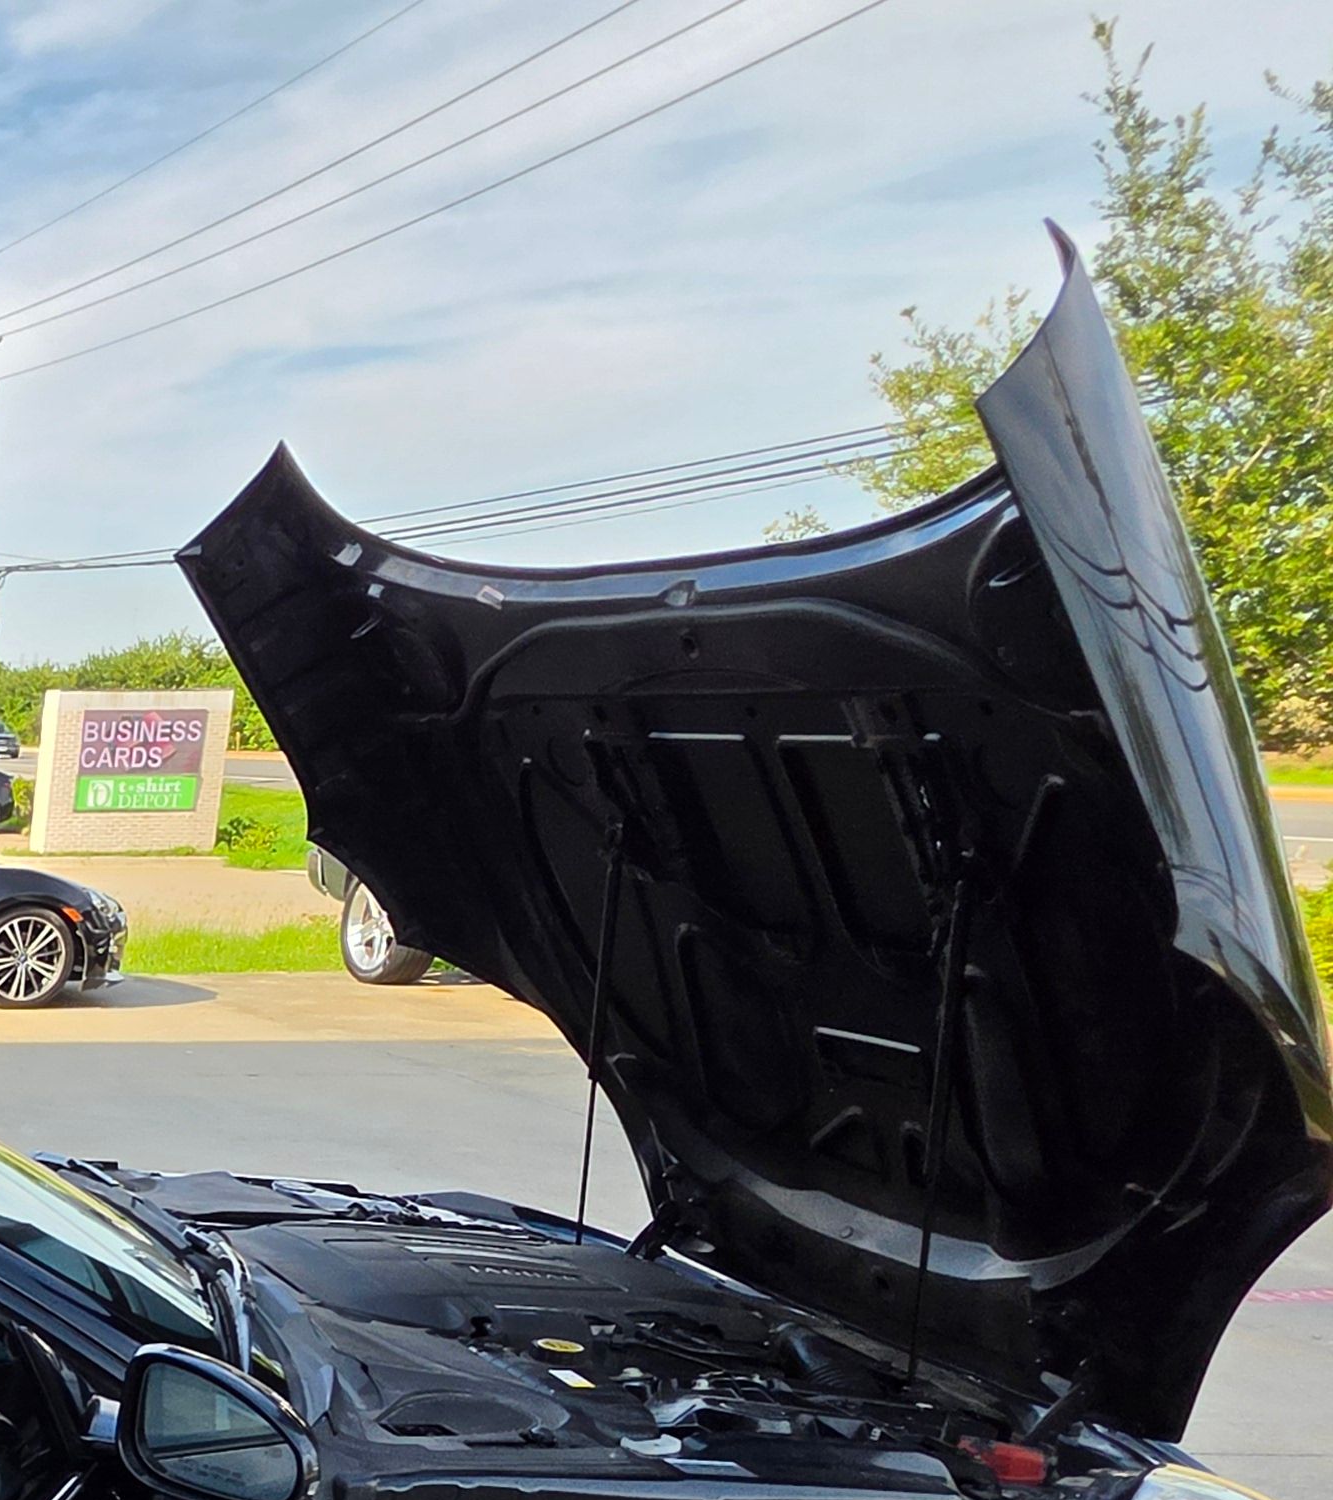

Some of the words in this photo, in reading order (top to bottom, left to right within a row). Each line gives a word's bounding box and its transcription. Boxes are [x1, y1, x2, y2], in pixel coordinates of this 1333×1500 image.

[83, 720, 202, 743] BUSINESS
[81, 746, 163, 768] CARDS
[117, 793, 183, 809] DEPOT
